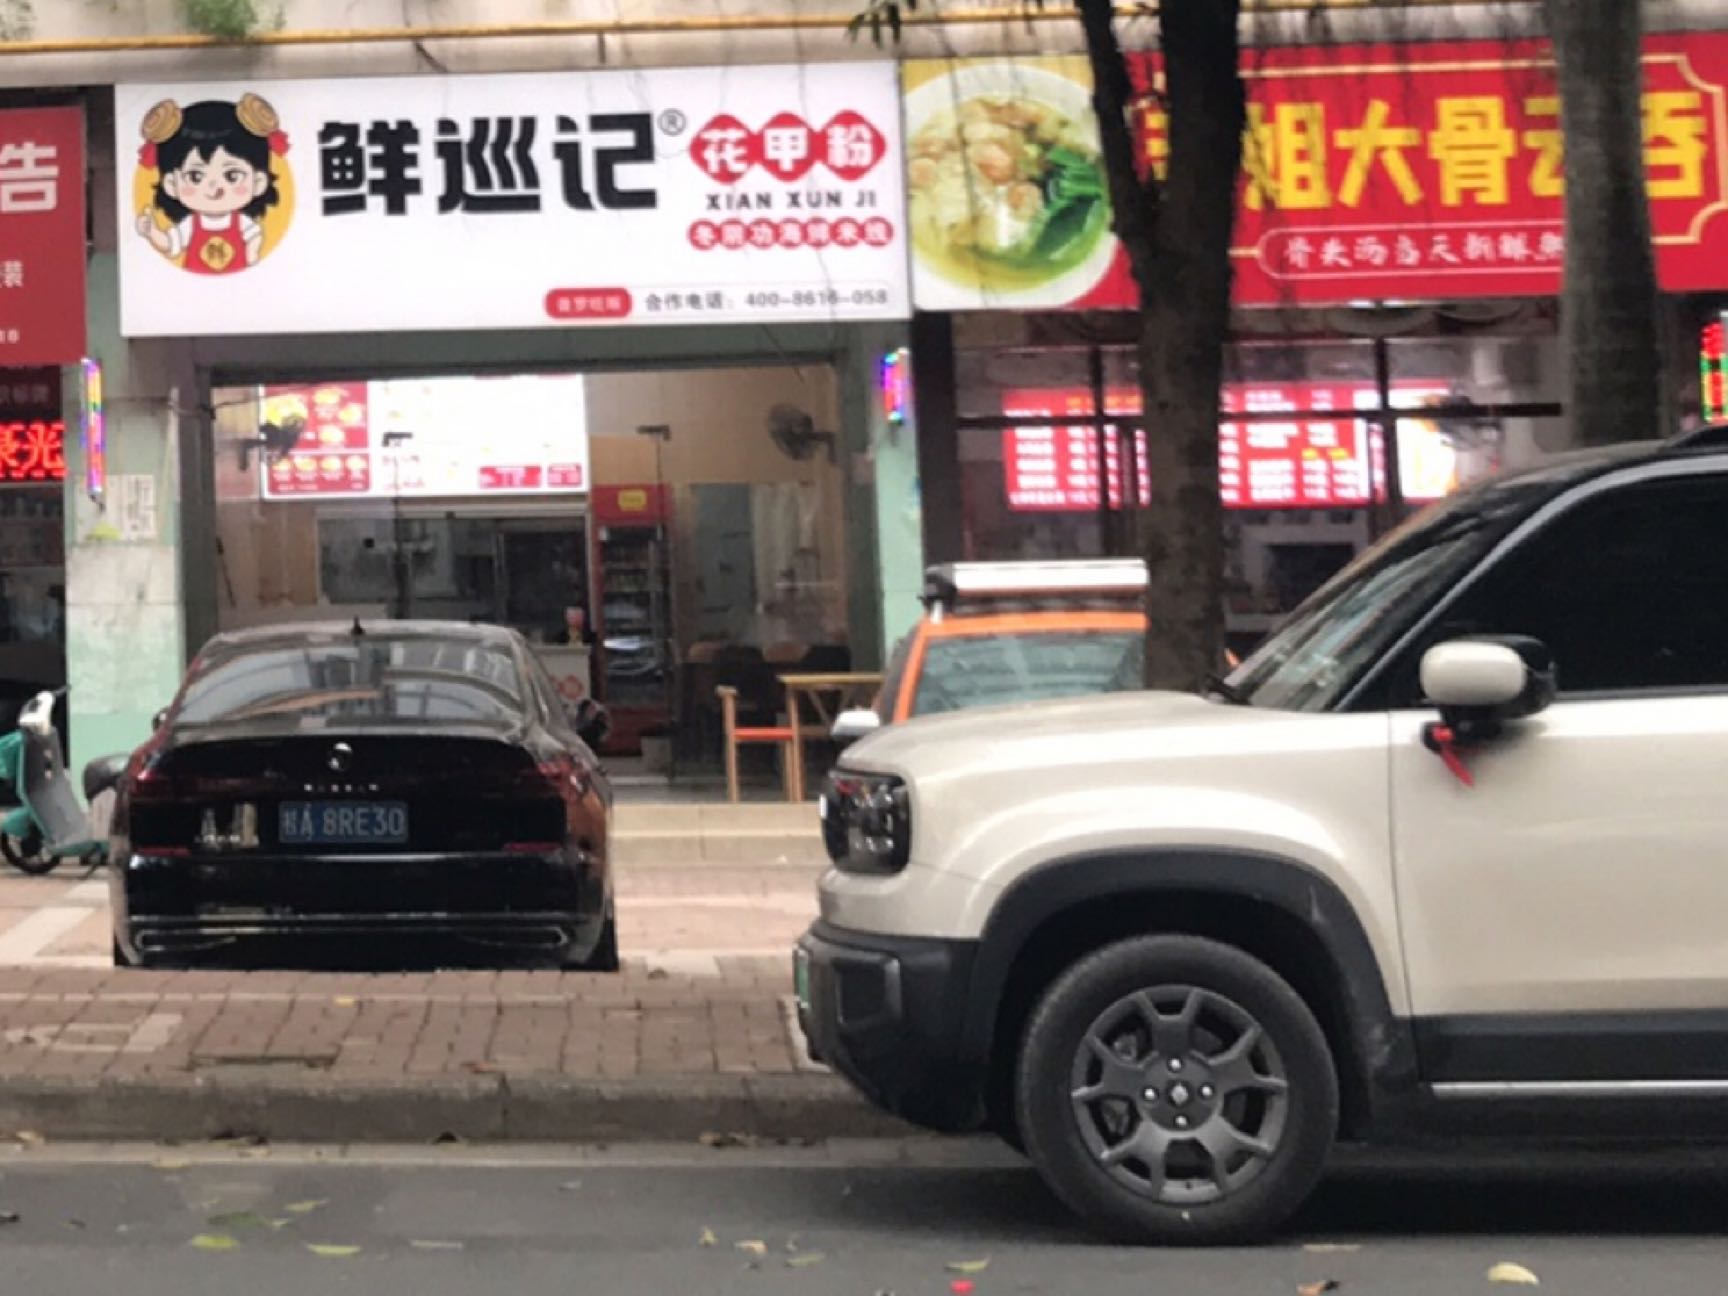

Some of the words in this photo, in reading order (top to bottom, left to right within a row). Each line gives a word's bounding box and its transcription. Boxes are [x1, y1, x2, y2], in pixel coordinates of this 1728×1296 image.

[318, 112, 658, 216] 鲜巡记
[699, 122, 875, 174] 花甲粉
[706, 192, 773, 210] XIAN
[787, 191, 842, 208] XUN
[855, 191, 877, 207] JI
